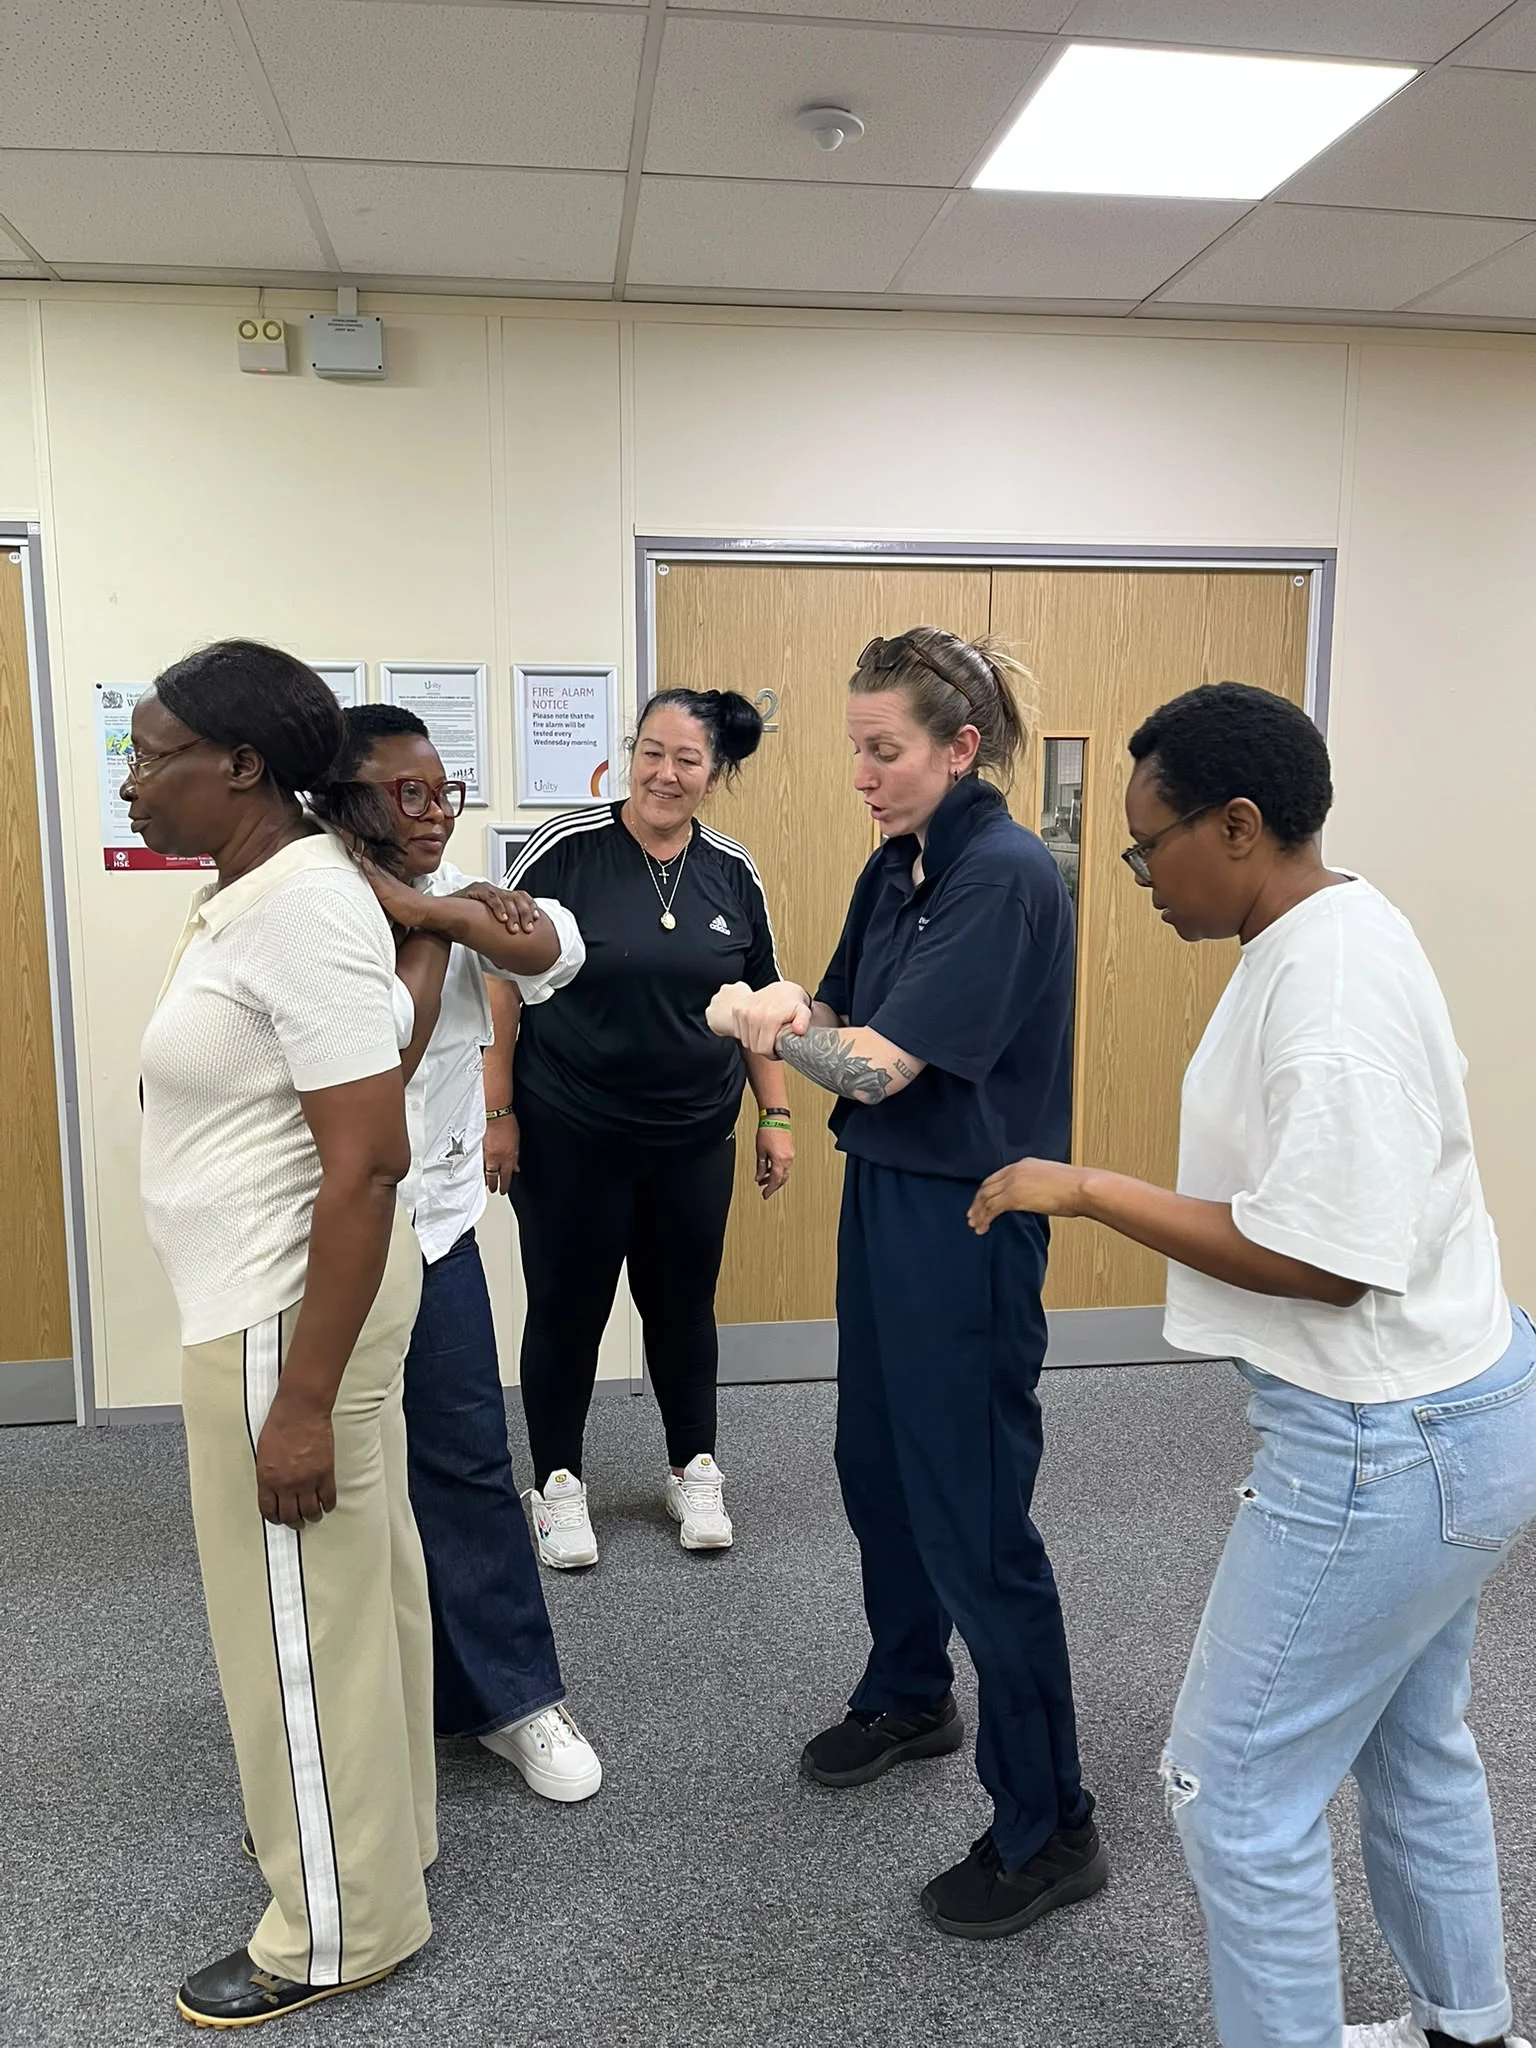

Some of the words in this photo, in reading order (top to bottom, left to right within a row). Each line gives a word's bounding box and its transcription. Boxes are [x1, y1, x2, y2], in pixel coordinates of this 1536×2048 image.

[532, 687, 554, 697] FIRE
[561, 687, 595, 697] ALARM
[532, 699, 569, 709] NOTICE
[755, 687, 779, 733] 2
[532, 712, 554, 720] Please
[533, 739, 570, 747] Wednesday
[570, 739, 597, 747] morning
[534, 780, 558, 792] Unity
[113, 860, 130, 868] HSE
